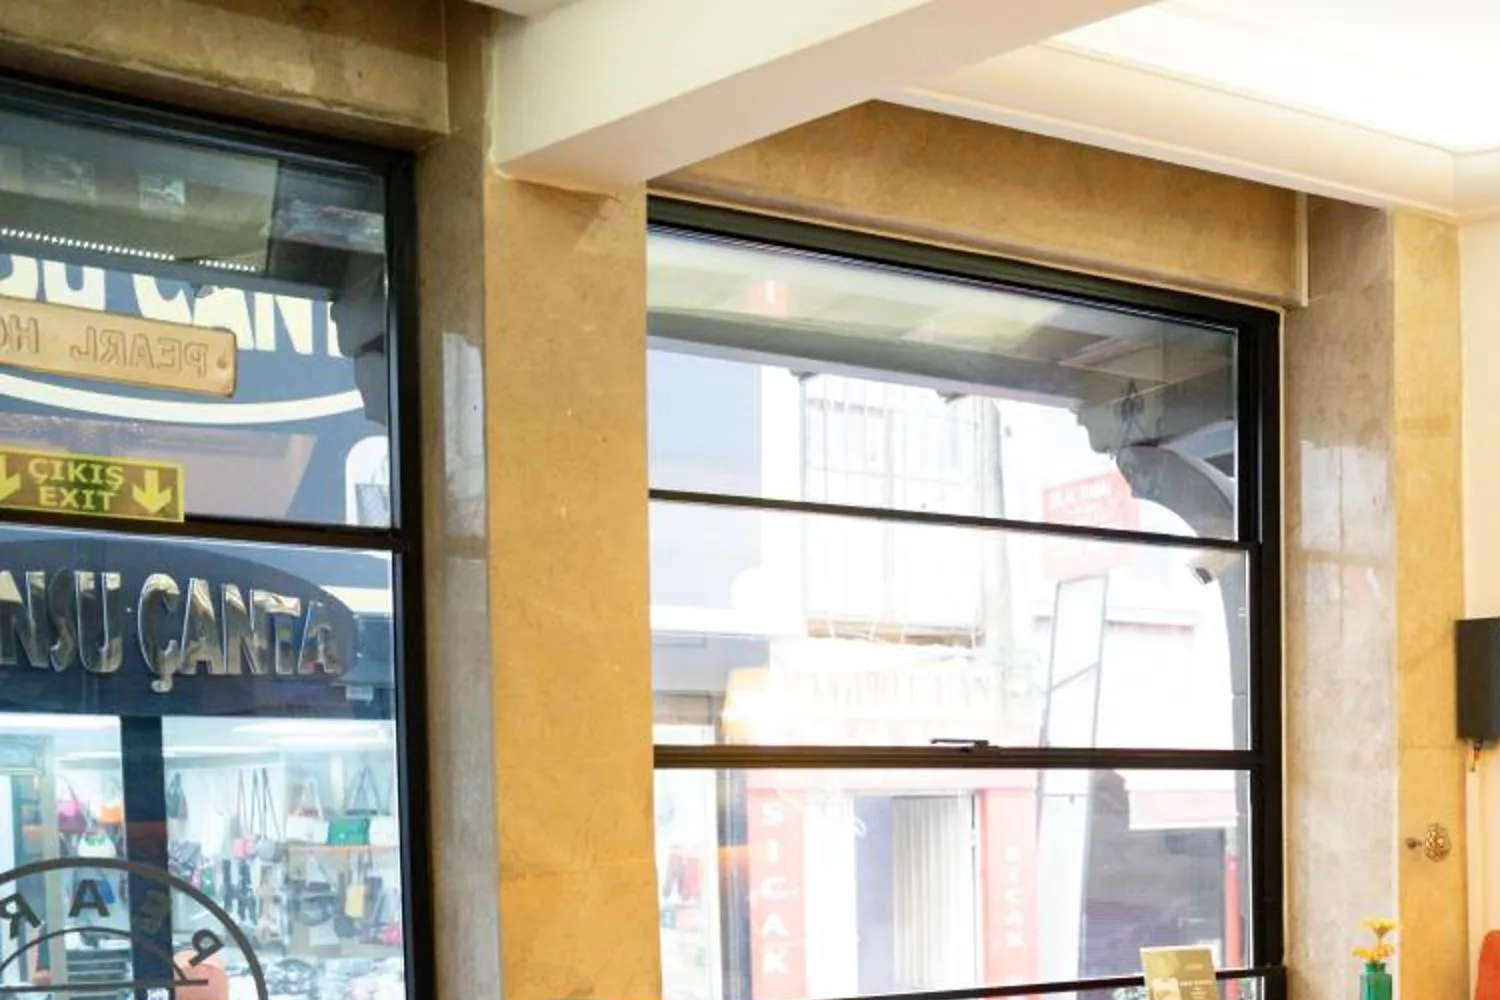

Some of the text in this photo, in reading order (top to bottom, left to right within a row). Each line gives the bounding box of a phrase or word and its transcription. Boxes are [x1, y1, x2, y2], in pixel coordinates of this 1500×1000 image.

[28, 458, 124, 491] ÇIKIŞ
[39, 486, 117, 511] EXIT
[137, 572, 344, 692] ÇANTA
[760, 802, 790, 974] SICAK
